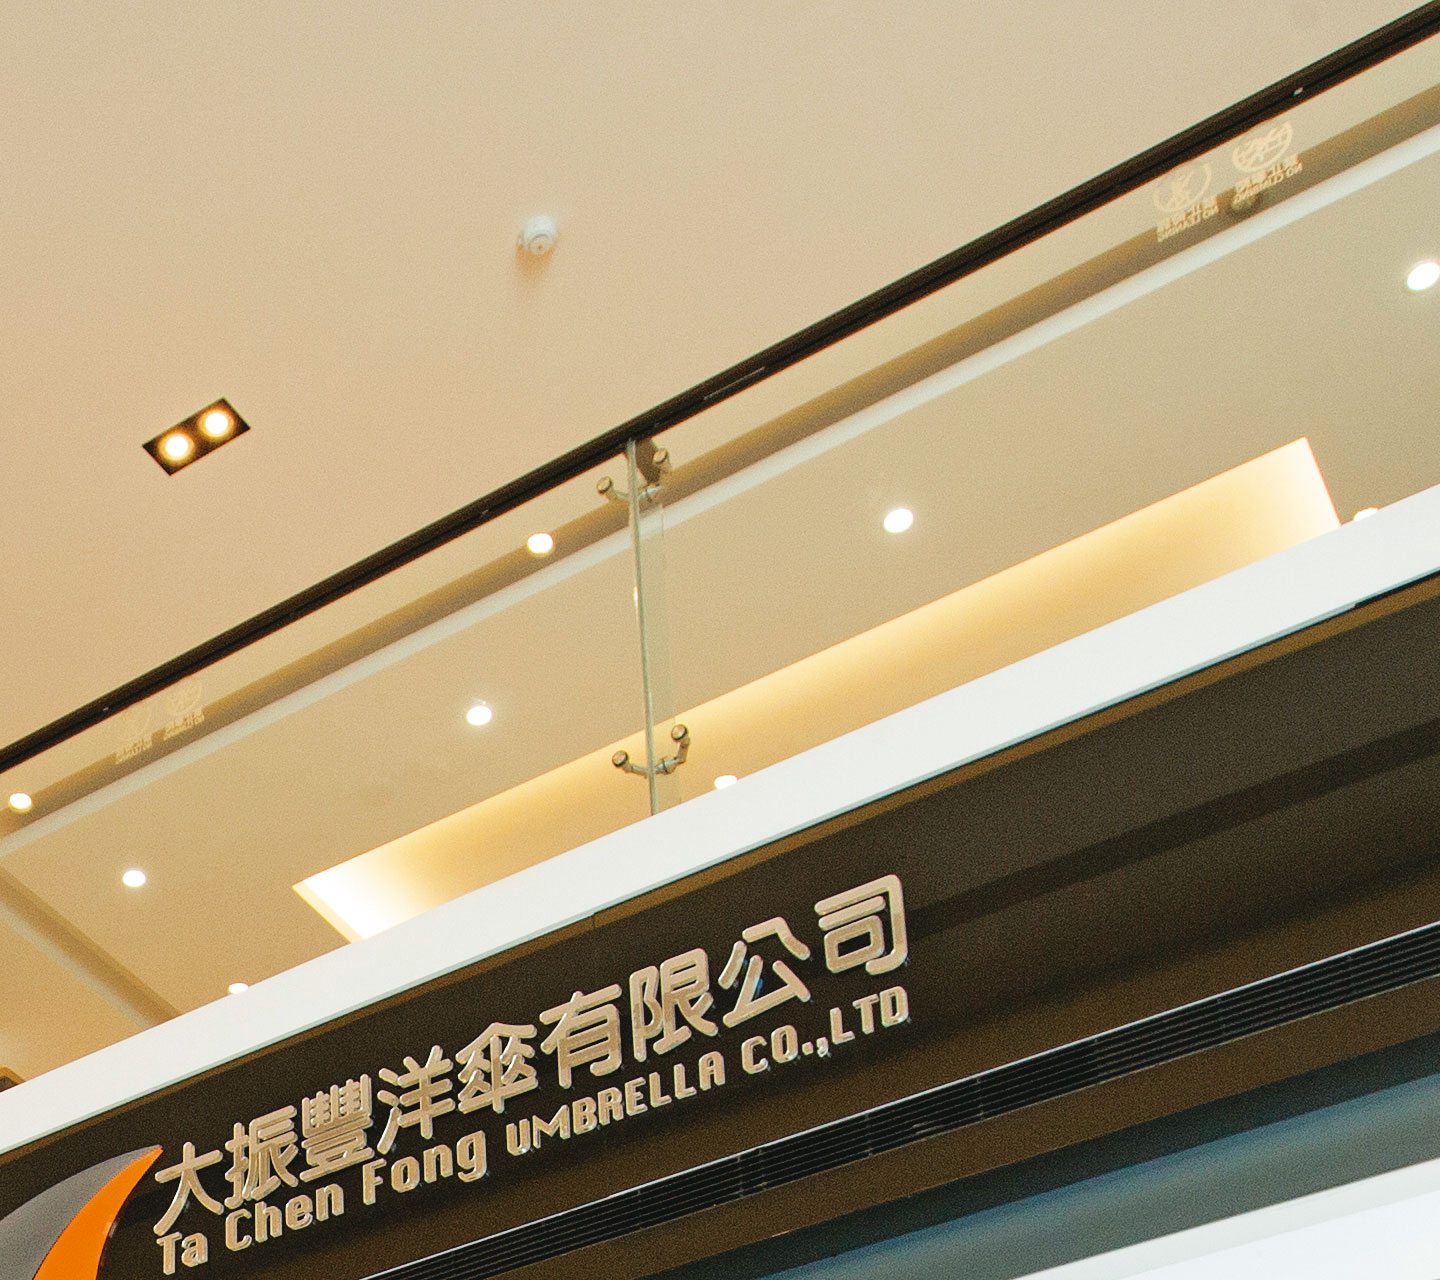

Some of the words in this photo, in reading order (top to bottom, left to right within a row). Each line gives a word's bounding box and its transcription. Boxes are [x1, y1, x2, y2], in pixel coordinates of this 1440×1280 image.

[153, 873, 910, 1236] 大振豐洋傘有限公司
[155, 1231, 208, 1275] Ta
[224, 1185, 345, 1251] Chen
[363, 1135, 488, 1206] Fong
[506, 1053, 726, 1157] UMBRELLA
